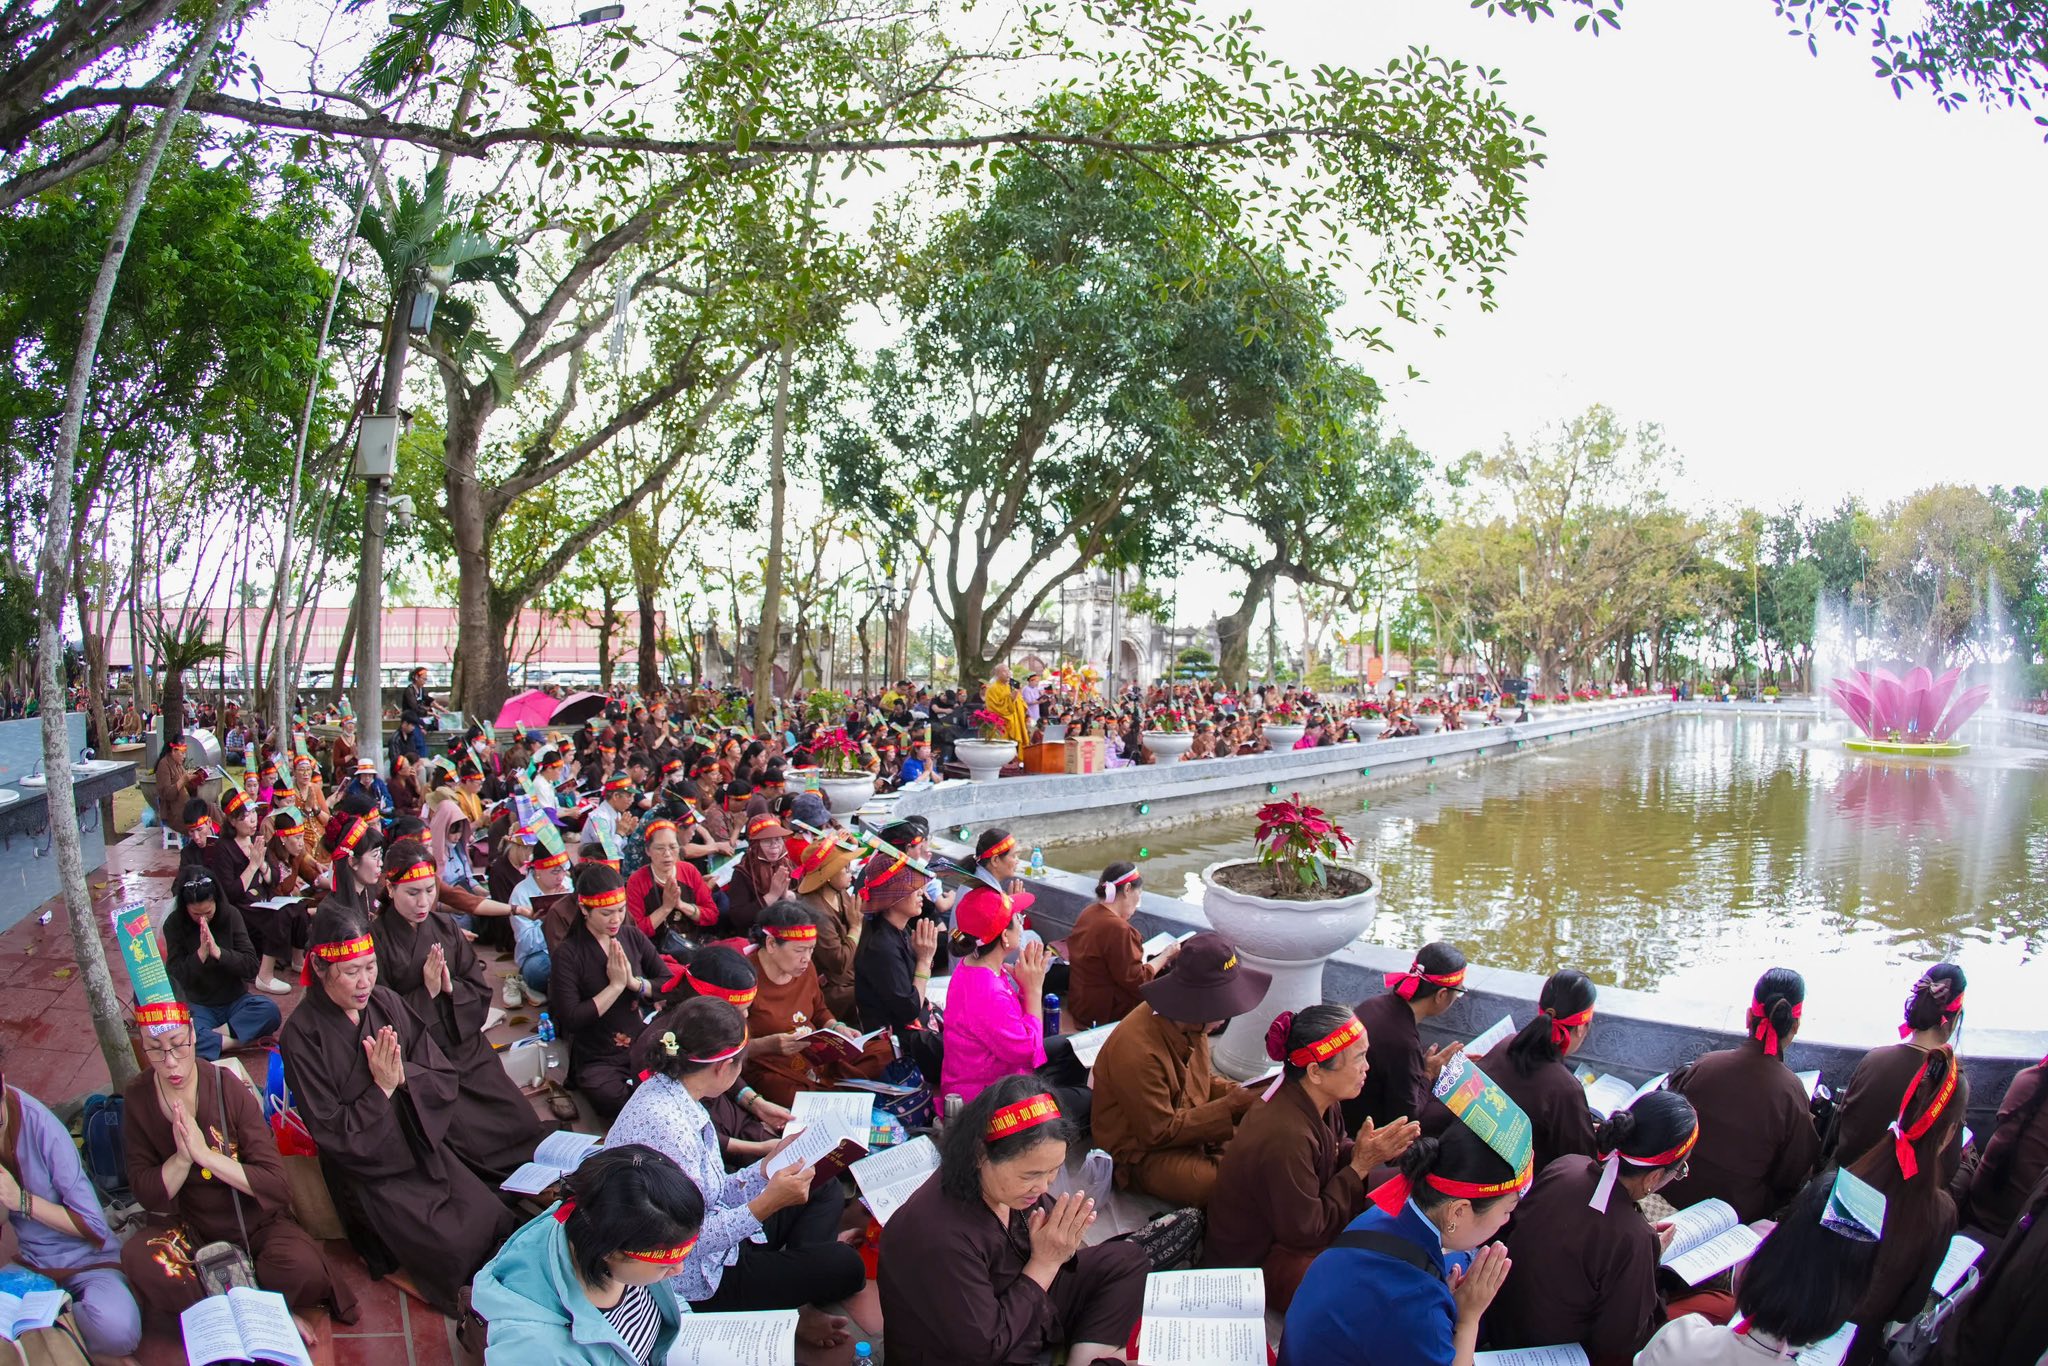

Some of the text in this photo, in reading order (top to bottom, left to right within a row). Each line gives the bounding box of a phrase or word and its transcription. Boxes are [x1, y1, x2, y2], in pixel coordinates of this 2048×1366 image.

[1316, 1042, 1334, 1056] CHÙA
[1330, 1036, 1343, 1049] TÂN
[1340, 1030, 1351, 1043] HẢI
[992, 1116, 1007, 1132] TÂN
[1003, 1109, 1018, 1128] HẢI
[1019, 1106, 1031, 1121] DU
[1029, 1100, 1048, 1118] XUÂN
[651, 1248, 666, 1260] HẢI
